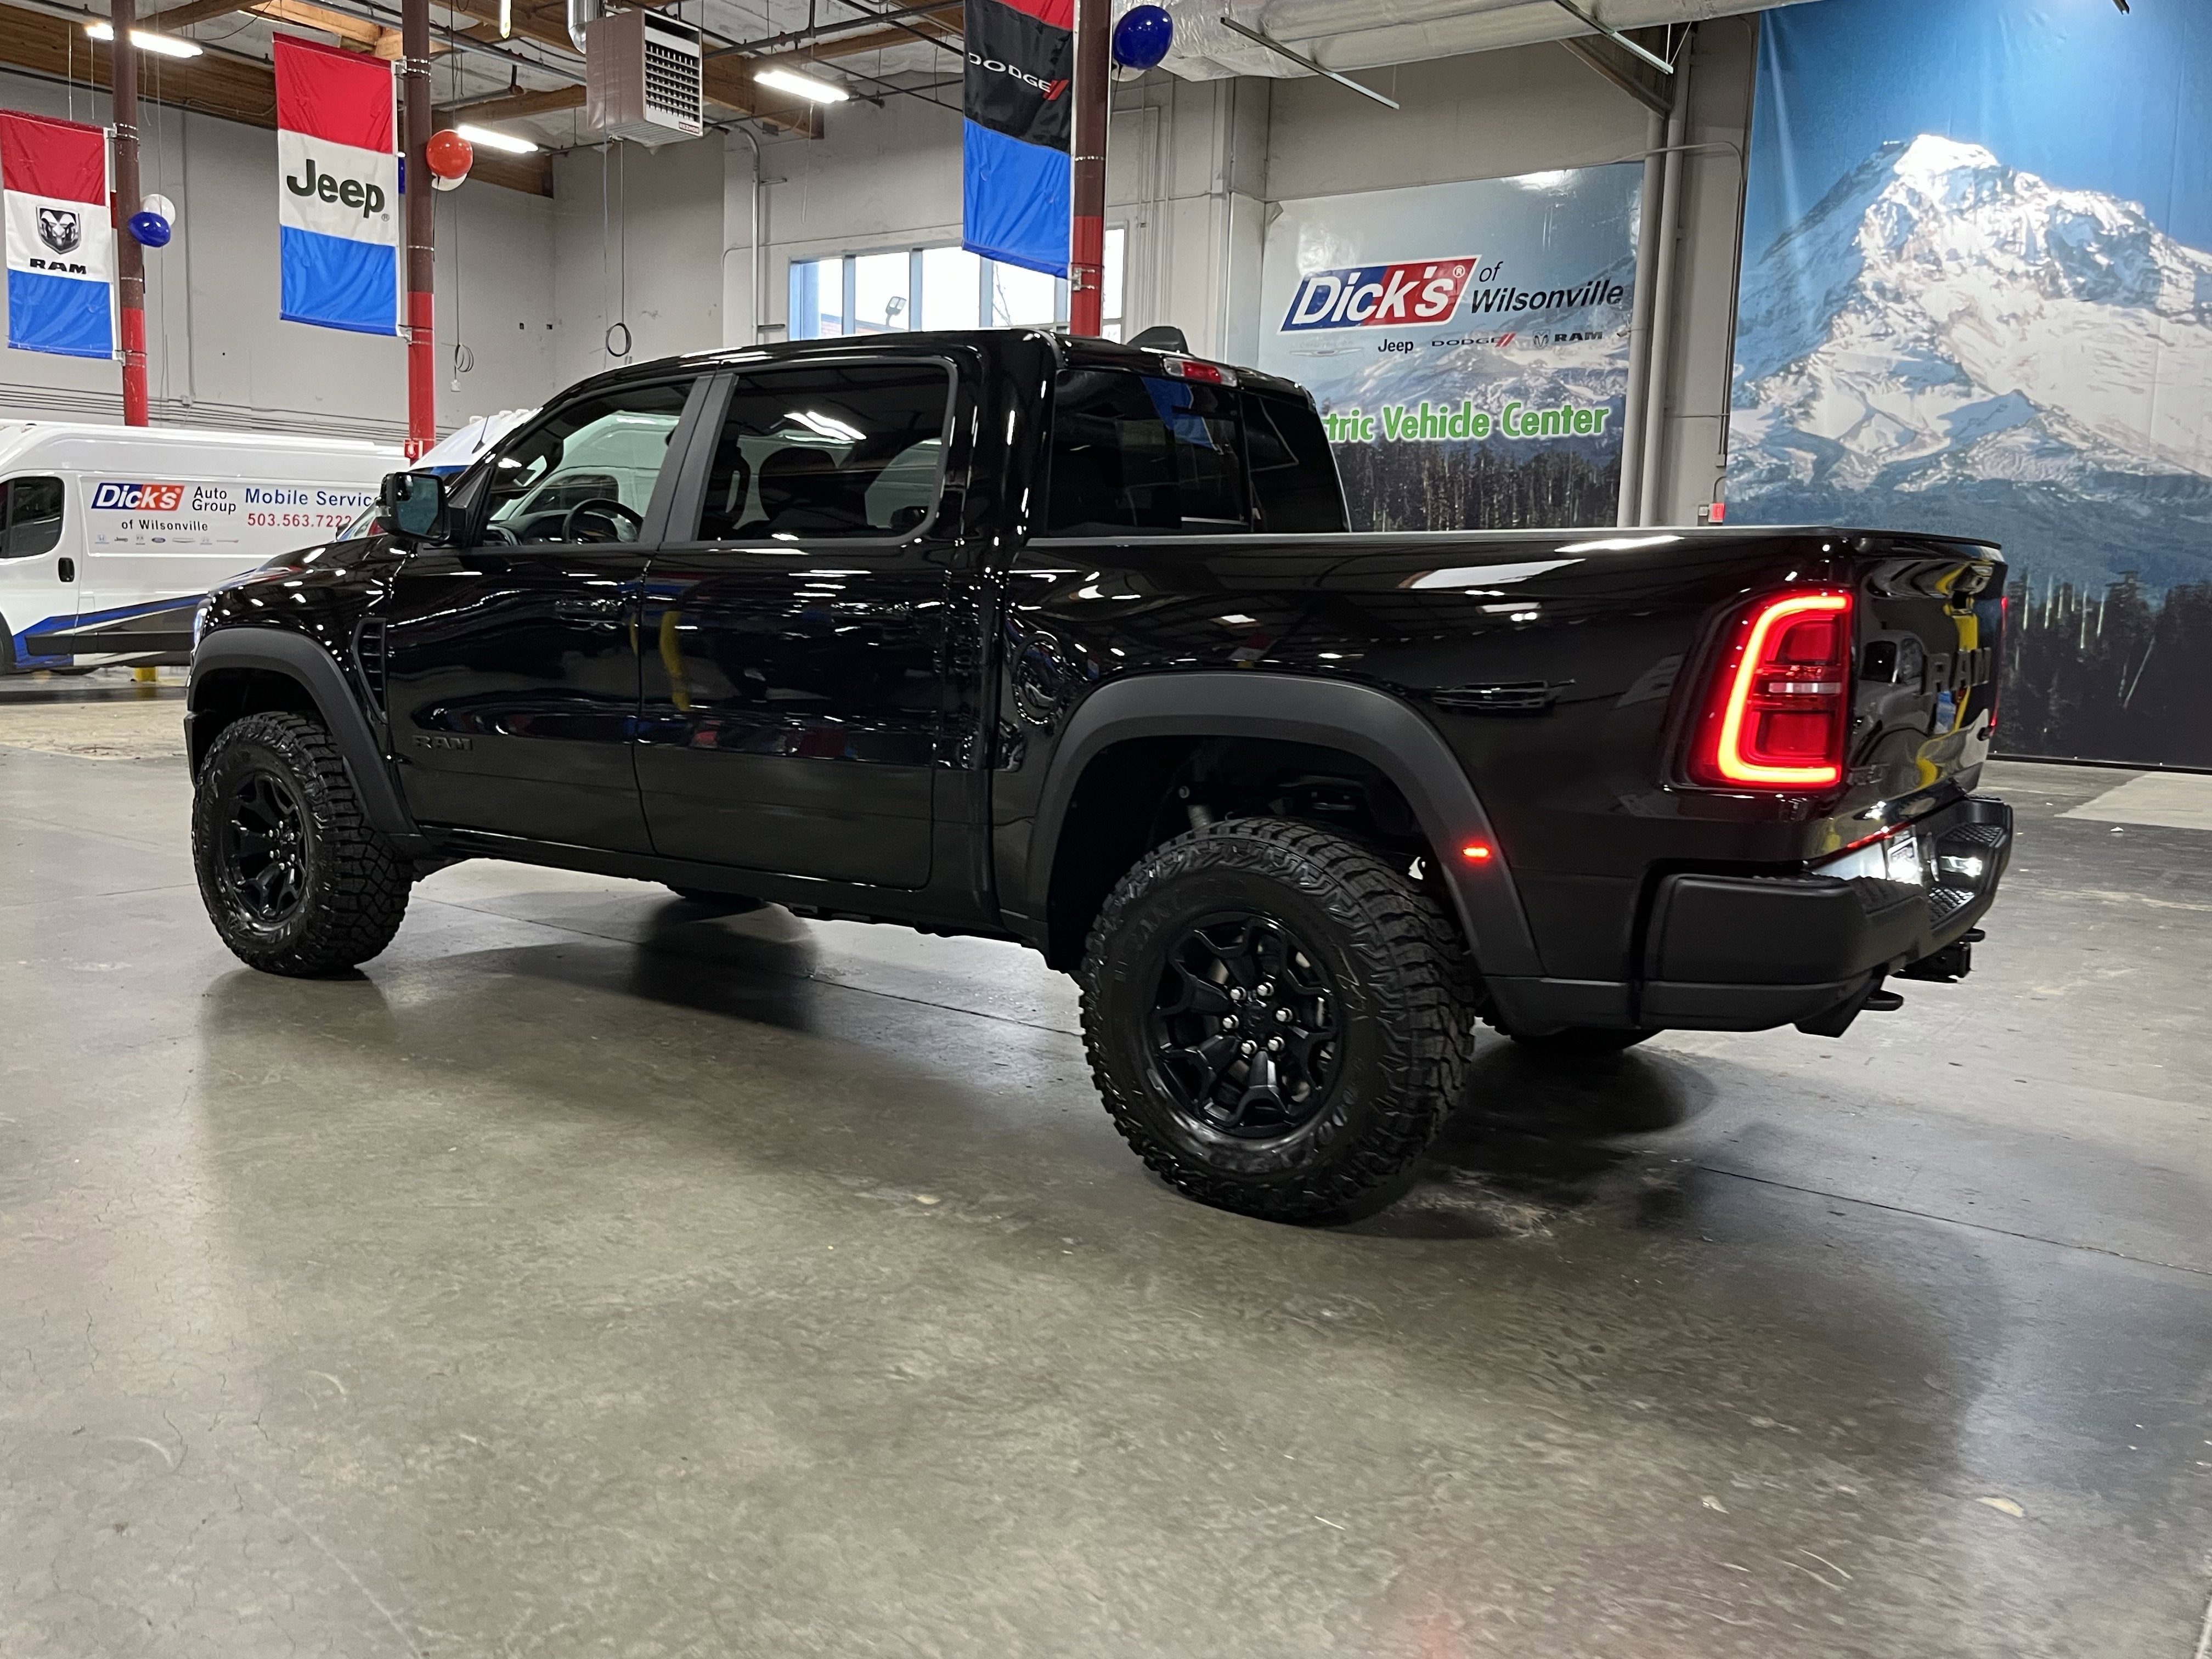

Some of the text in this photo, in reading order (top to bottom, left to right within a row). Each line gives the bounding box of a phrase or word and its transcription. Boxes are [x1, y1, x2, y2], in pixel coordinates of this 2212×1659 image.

[969, 53, 1052, 93] DODGE
[287, 159, 385, 219] Jeep
[30, 258, 87, 274] RAM
[1479, 261, 1503, 282] of
[1291, 266, 1455, 325] Dick's
[1471, 278, 1624, 313] Wilsonville
[1431, 336, 1502, 347] DODGE
[1554, 331, 1602, 342] RAM
[1378, 338, 1414, 354] Jeep
[1321, 402, 1609, 441] tric Vehicle Center
[96, 485, 177, 509] Dick's
[194, 486, 227, 499] Auto
[245, 488, 373, 507] Mobile Servic
[192, 499, 236, 515] Group
[121, 520, 208, 531] of Wilsonville
[413, 735, 473, 751] RAM
